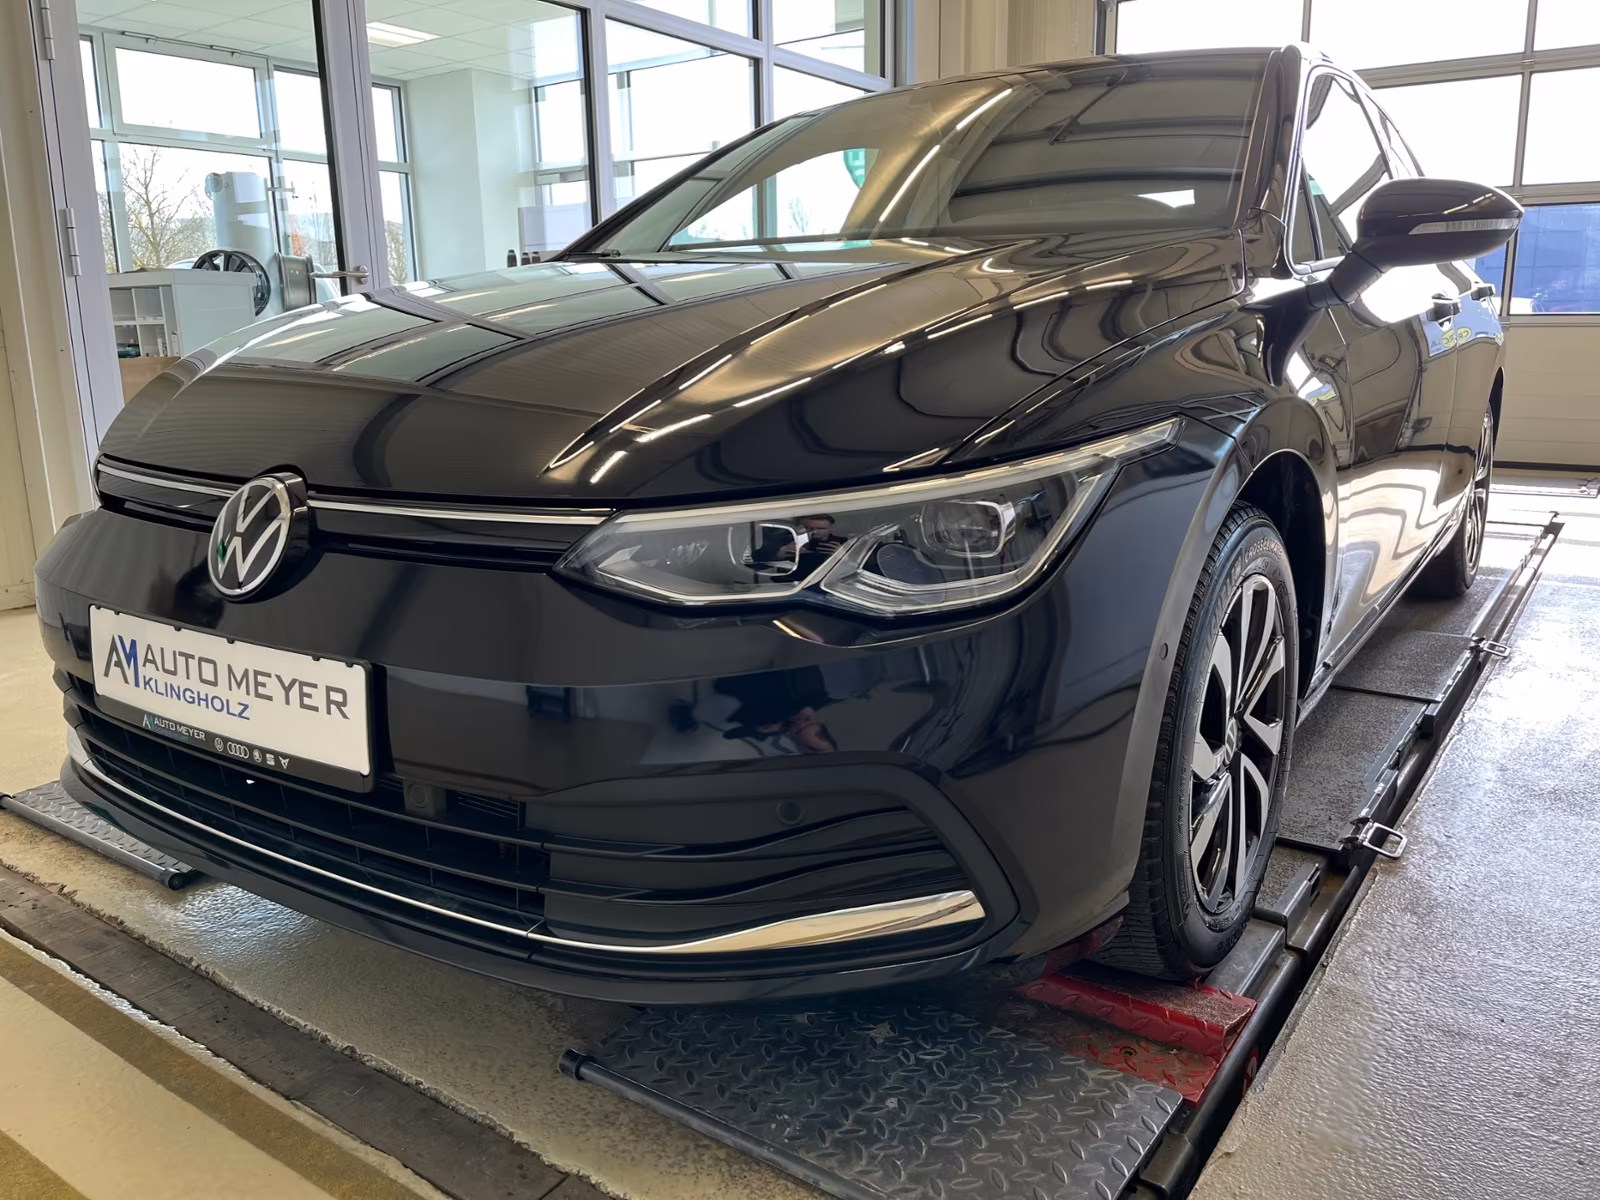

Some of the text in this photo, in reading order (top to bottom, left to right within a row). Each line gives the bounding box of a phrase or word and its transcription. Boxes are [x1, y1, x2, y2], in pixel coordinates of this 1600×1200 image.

[142, 643, 350, 720] AUTO MEYER
[143, 675, 250, 720] KLINGHOLZ
[154, 717, 176, 731] AUTO
[176, 724, 206, 741] MEYER
